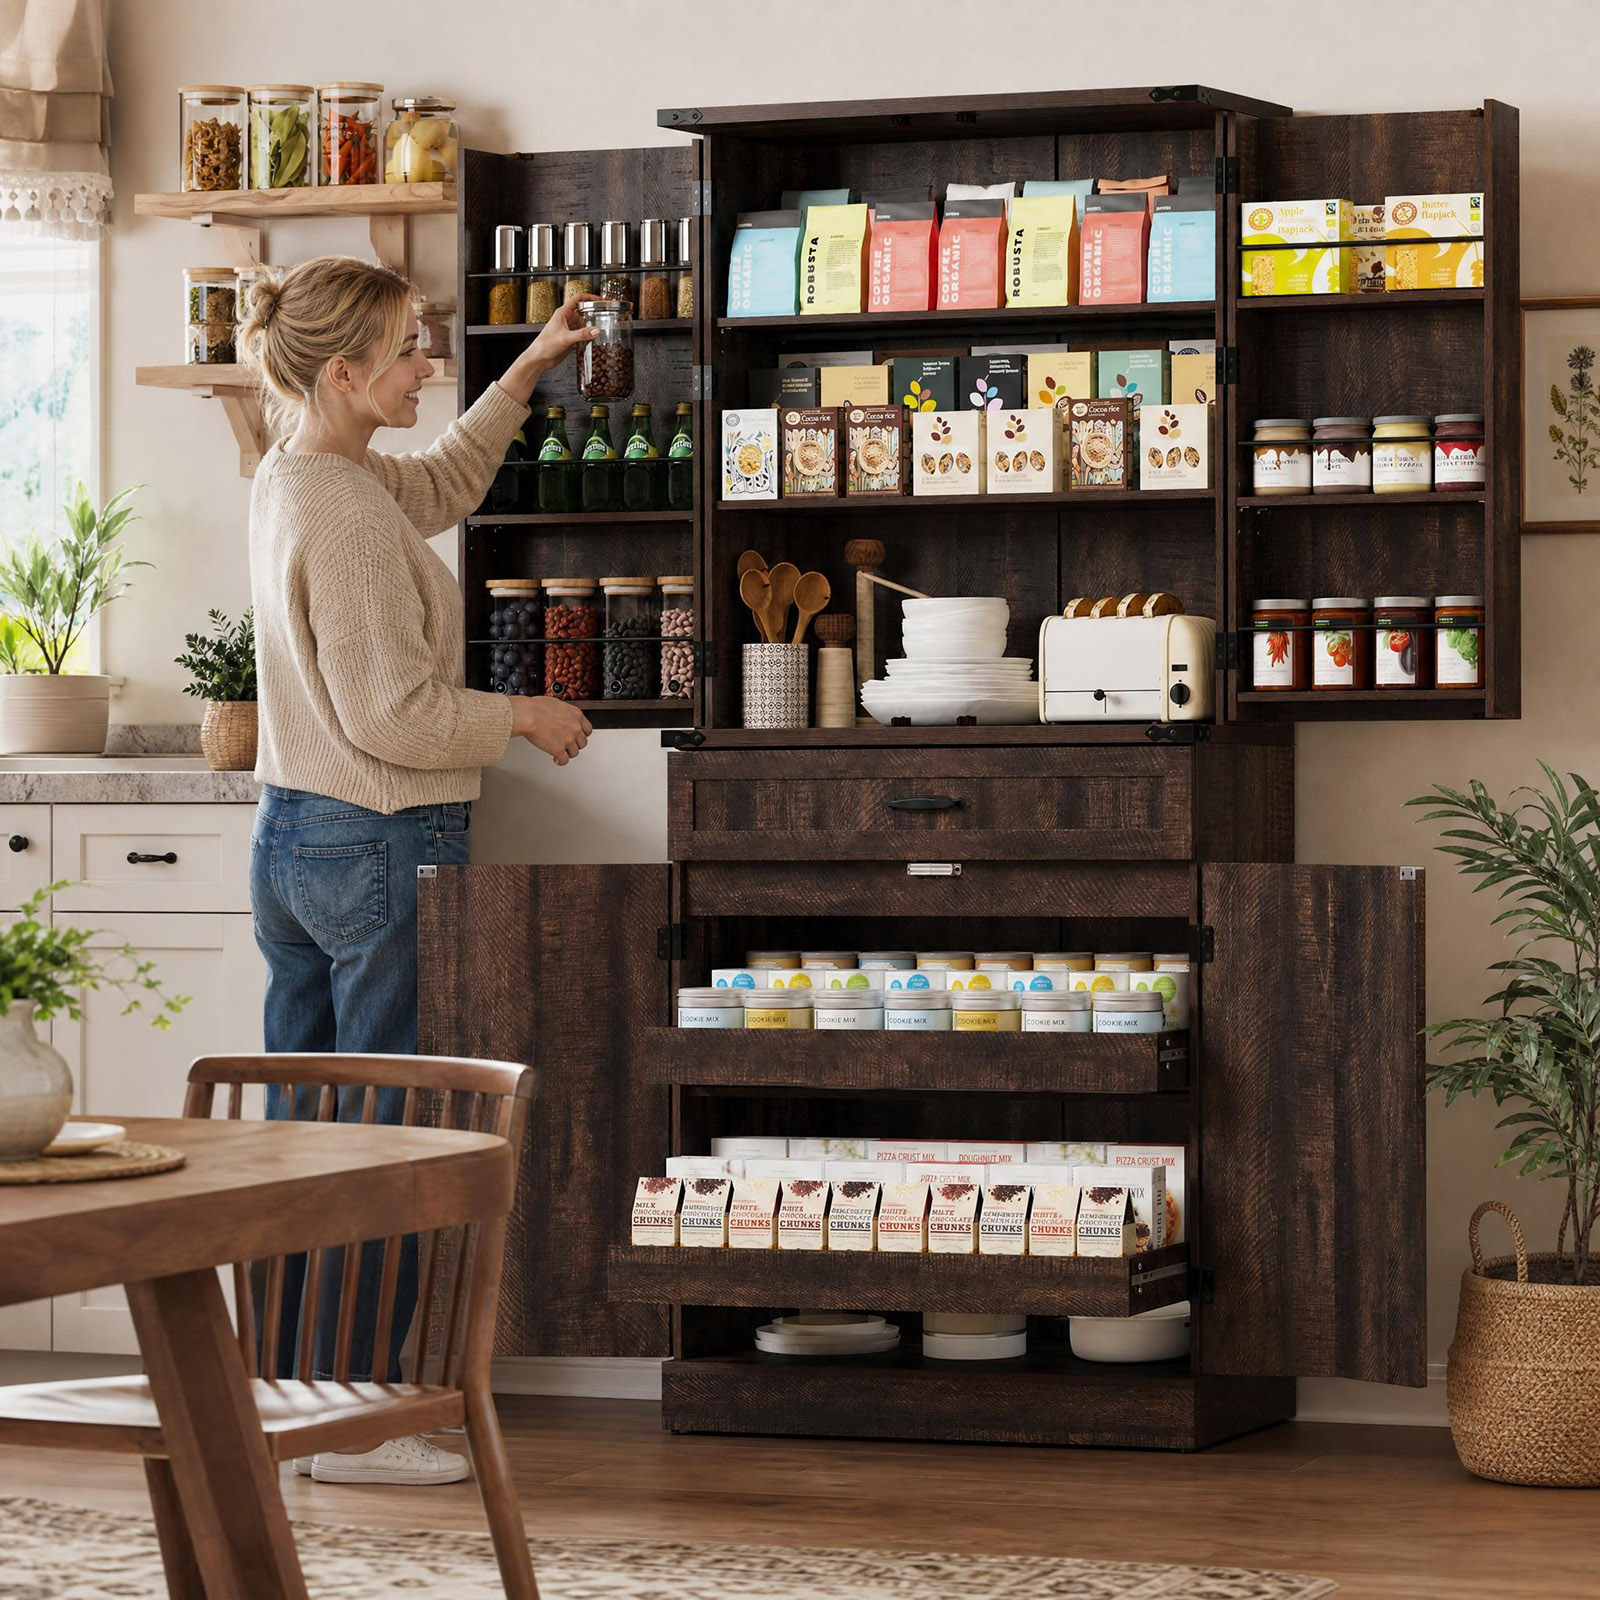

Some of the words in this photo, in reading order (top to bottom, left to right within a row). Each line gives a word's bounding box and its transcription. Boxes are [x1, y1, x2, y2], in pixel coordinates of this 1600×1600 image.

[1421, 200, 1449, 209] Butter
[1278, 207, 1304, 217] Apple
[1421, 210, 1457, 220] flapjack
[1013, 229, 1025, 297] ROBUSTA
[1093, 229, 1102, 298] ORGANIC
[1162, 227, 1173, 294] ORGANIC
[807, 236, 820, 305] ROBUSTA
[882, 237, 892, 306] ORGANIC
[951, 235, 961, 303] ORGANIC
[820, 414, 831, 422] rice
[884, 412, 896, 420] rice
[877, 1152, 896, 1161] PIZZA
[898, 1152, 920, 1161] CRUST
[922, 1153, 936, 1162] MIX
[959, 1154, 998, 1163] DOUGHNUT
[999, 1154, 1012, 1163] MIX
[1116, 1157, 1136, 1165] PIZZA
[1137, 1157, 1160, 1166] CRUST
[1161, 1158, 1175, 1166] MIX
[634, 1208, 675, 1216] CHOCOLATE
[731, 1211, 772, 1219] CHOCOLATE
[633, 1216, 673, 1225] CHUNKS
[682, 1217, 722, 1226] CHUNKS
[730, 1219, 771, 1227] CHUNKS
[780, 1220, 821, 1228] CHUNKS
[830, 1221, 871, 1229] CHUNKS
[880, 1222, 920, 1230] CHUNKS
[930, 1223, 971, 1231] CHUNKS
[981, 1224, 1022, 1233] CHUNKS
[1031, 1225, 1072, 1234] CHUNKS
[1078, 1226, 1121, 1235] CHUNKS
